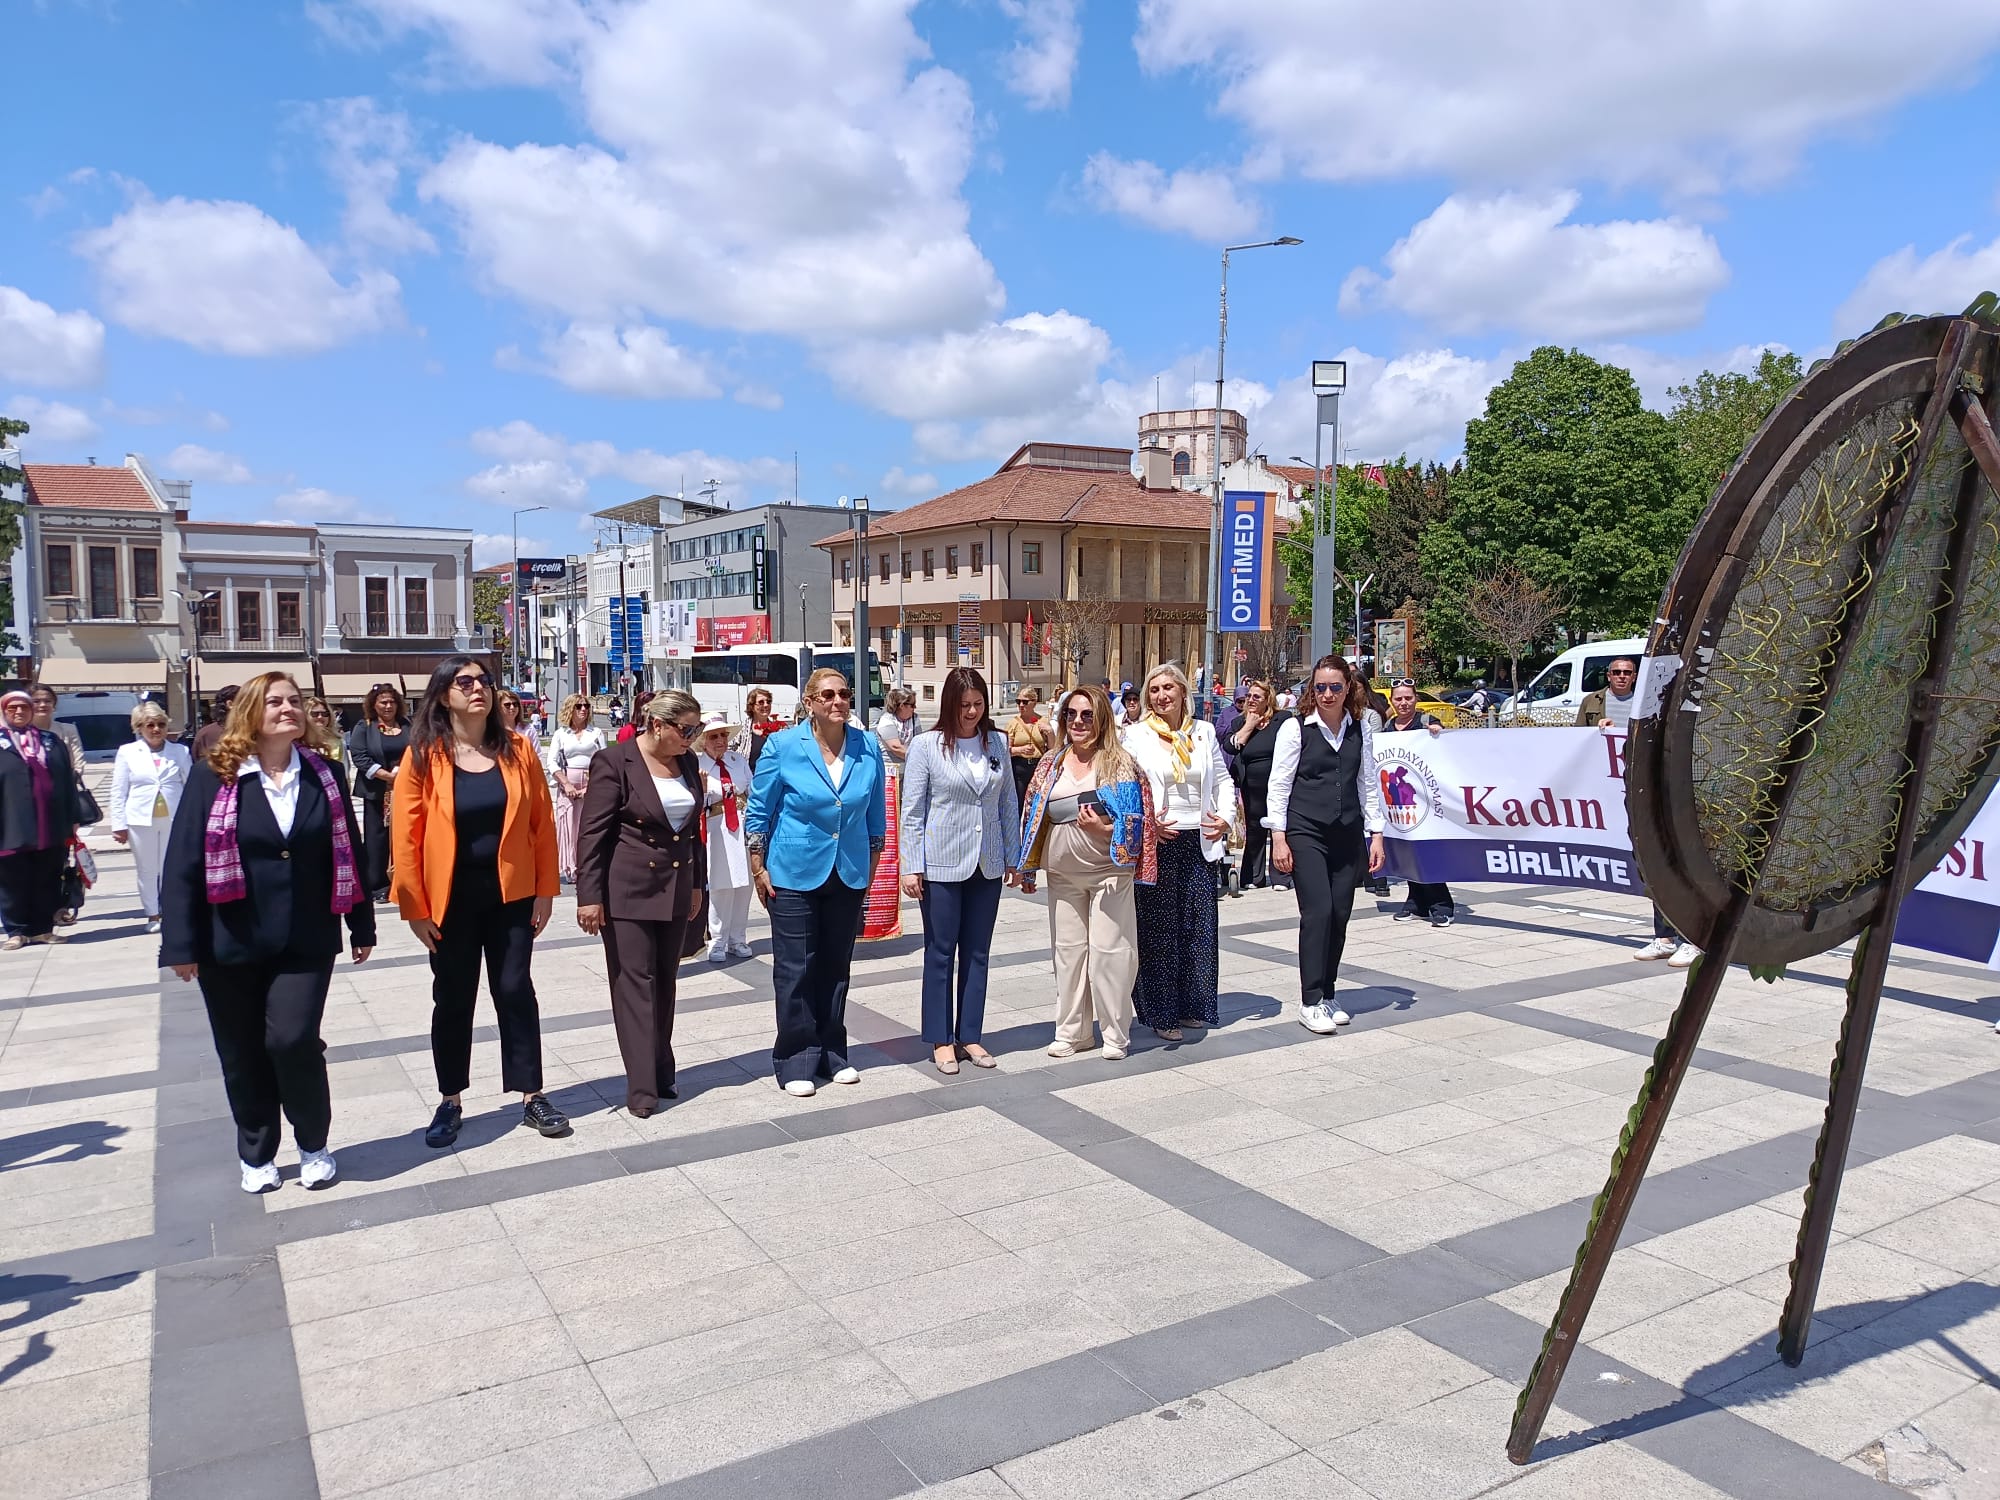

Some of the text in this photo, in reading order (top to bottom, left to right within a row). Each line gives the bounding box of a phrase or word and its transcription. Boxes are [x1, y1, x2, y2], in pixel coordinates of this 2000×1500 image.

[755, 536, 764, 609] HOTEL
[1397, 747, 1444, 819] DAYANIŞMASI
[1459, 786, 1607, 830] Kadın
[1485, 844, 1631, 886] BİRLİKTE
